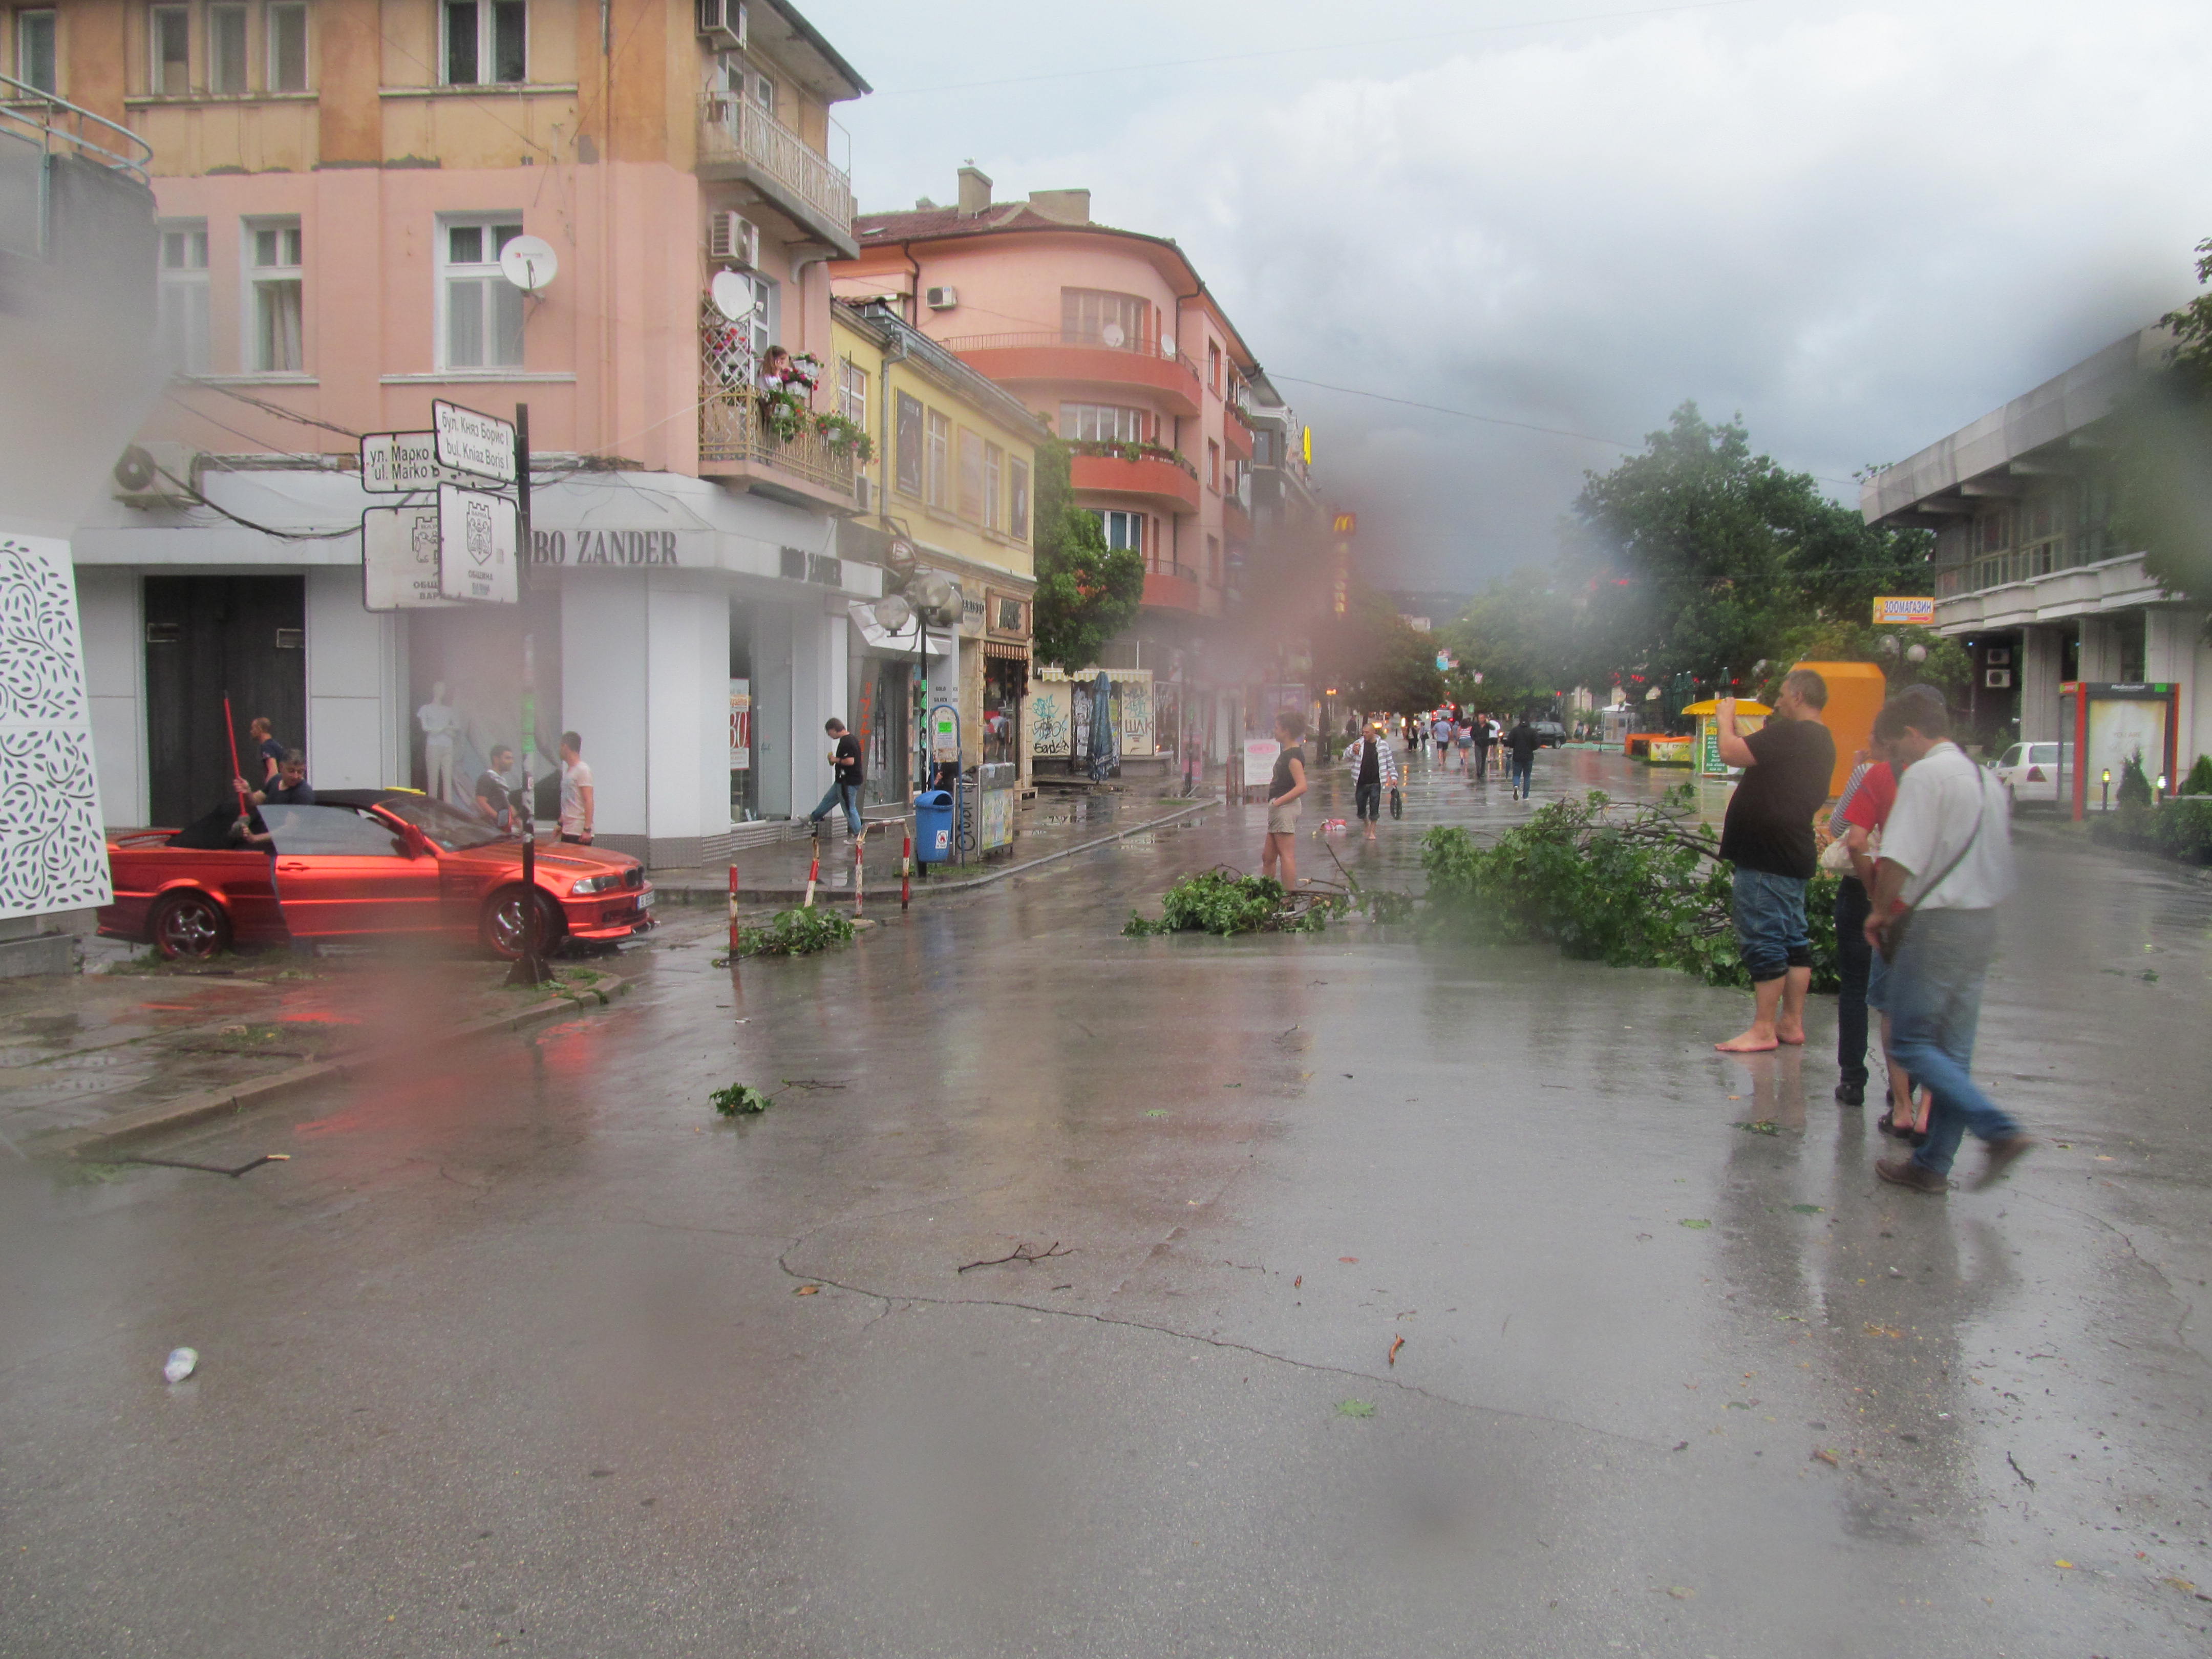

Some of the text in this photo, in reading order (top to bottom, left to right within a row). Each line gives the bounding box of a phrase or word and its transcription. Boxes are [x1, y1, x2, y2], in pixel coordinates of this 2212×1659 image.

[441, 411, 459, 433] бул.
[460, 417, 479, 437] Княз
[480, 422, 504, 445] Борис
[370, 445, 429, 467] ул. Марко
[446, 437, 461, 455] bul.
[462, 442, 484, 463] Kniaz
[485, 449, 505, 469] Boris
[375, 463, 388, 480] ul.
[392, 463, 428, 480] Marko
[577, 530, 677, 564] ZANDER
[1885, 601, 1931, 613] ЗООМАГАЗИН
